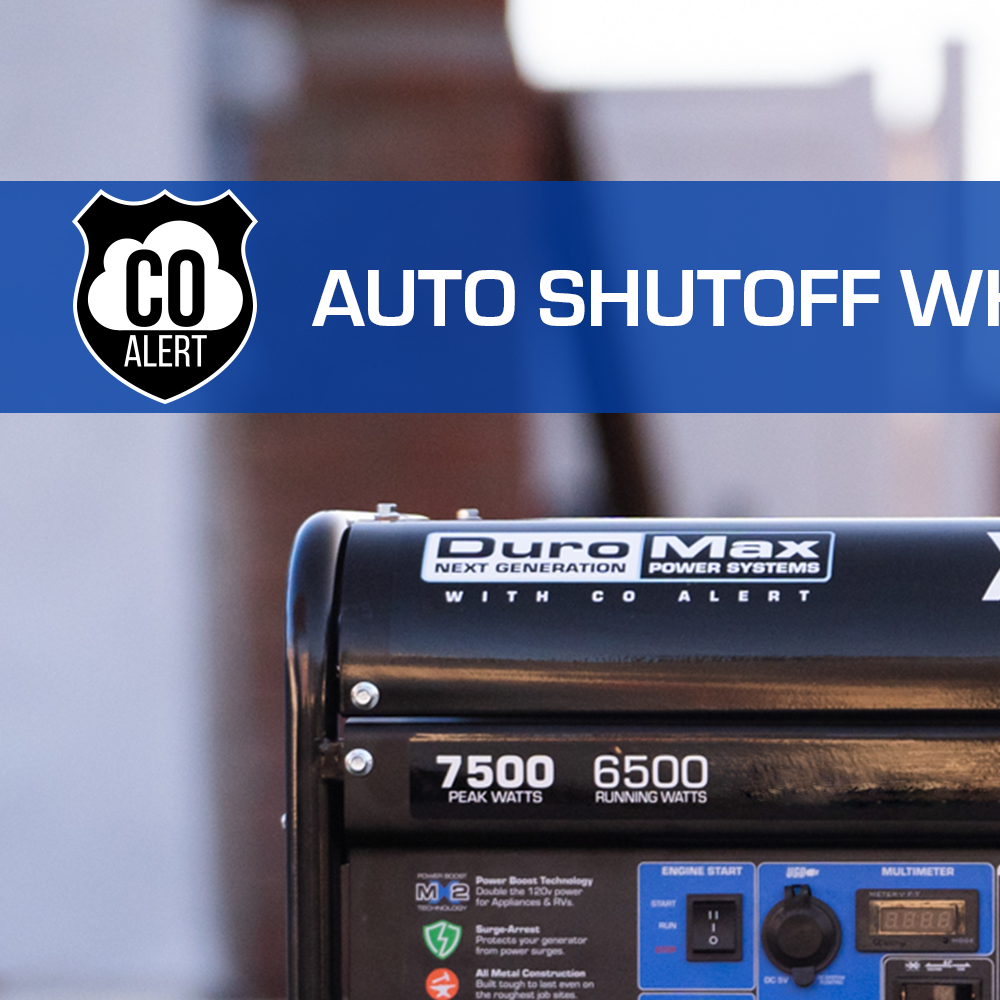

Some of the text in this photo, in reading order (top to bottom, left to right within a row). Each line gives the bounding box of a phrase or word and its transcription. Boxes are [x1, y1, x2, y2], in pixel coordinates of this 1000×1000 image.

[434, 562, 627, 574] NEXT GENERATION
[649, 562, 820, 574] POWER SYSTEMS
[445, 590, 810, 603] WITH CO ALERT
[436, 755, 555, 789] 7500
[593, 755, 709, 789] 6500
[448, 791, 543, 803] PEAK WATTS
[595, 791, 708, 803] RUNNING WATTS
[661, 866, 743, 876] ENGINE START
[881, 867, 955, 877] MULTIMETER
[476, 876, 593, 887] Power Boost Technology
[476, 887, 507, 896] Double
[510, 887, 525, 896] the
[554, 888, 583, 898] power
[476, 898, 489, 906] for
[491, 898, 541, 908] Appliances
[543, 898, 551, 906] &
[658, 922, 677, 930] RUN
[475, 936, 588, 946] Protects your generator
[475, 947, 565, 957] from power surges.
[476, 969, 586, 978] All Metal Construction
[476, 980, 497, 988] Built
[499, 980, 526, 990] tough
[527, 980, 538, 988] to
[540, 980, 557, 988] last
[476, 991, 577, 1000] the roughest job sites.
